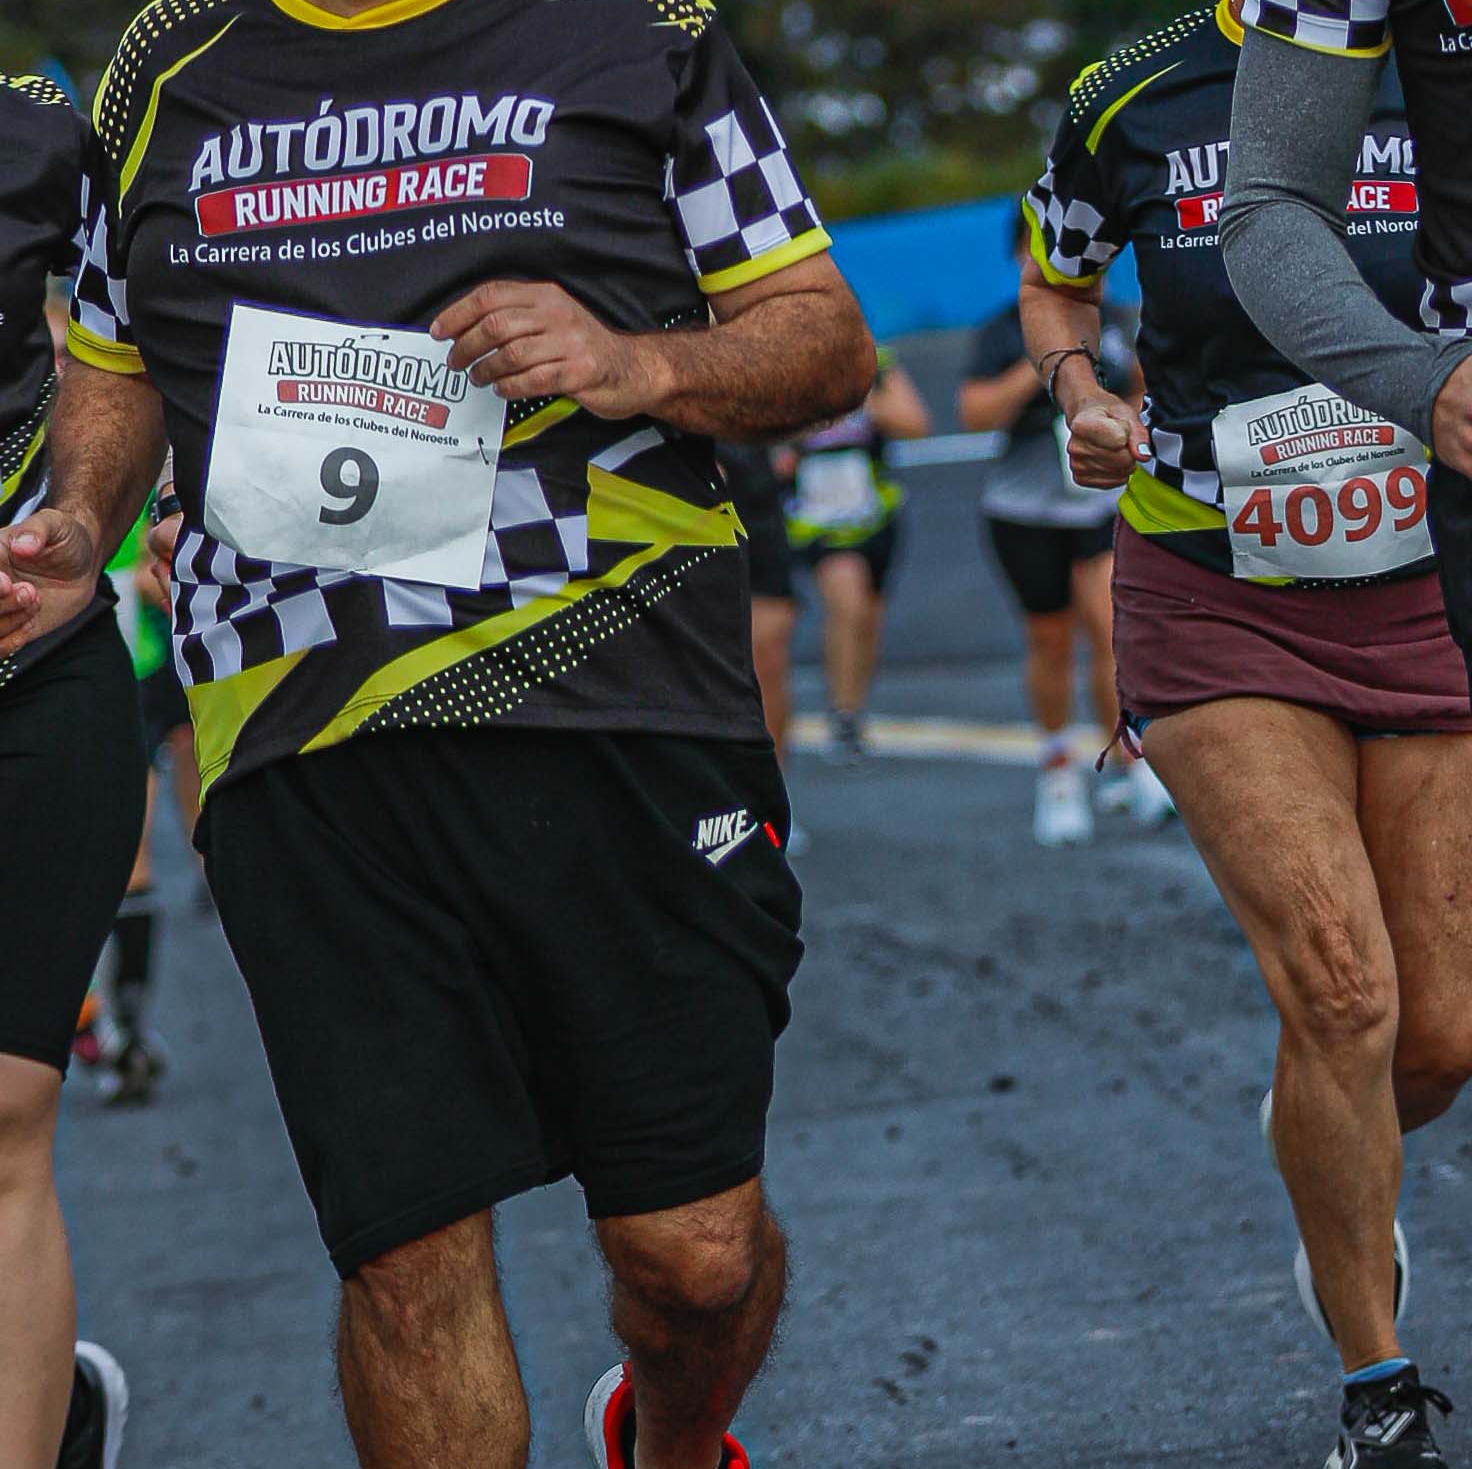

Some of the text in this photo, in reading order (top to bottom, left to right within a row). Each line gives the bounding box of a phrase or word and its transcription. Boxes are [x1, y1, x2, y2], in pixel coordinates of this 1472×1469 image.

[1439, 33, 1456, 53] La
[188, 94, 556, 193] AUTÓDROMO
[234, 162, 488, 228] RUNNING RACE
[170, 207, 564, 264] La Carrera de los Clubes del Noroeste
[1161, 235, 1173, 249] La
[1176, 234, 1219, 248] Carrer
[1347, 220, 1372, 236] del
[268, 338, 469, 403] AUTÓDROMO
[258, 403, 459, 446] La Carrera de los Clubes del Noroeste
[297, 383, 430, 423] RUNNING RACE
[1251, 447, 1405, 478] La Carrera de los Clubes del Noroeste
[1276, 429, 1380, 460] RUNNING RACE
[319, 446, 380, 525] 9
[1232, 466, 1427, 547] 4099
[696, 808, 747, 850] NIKE
